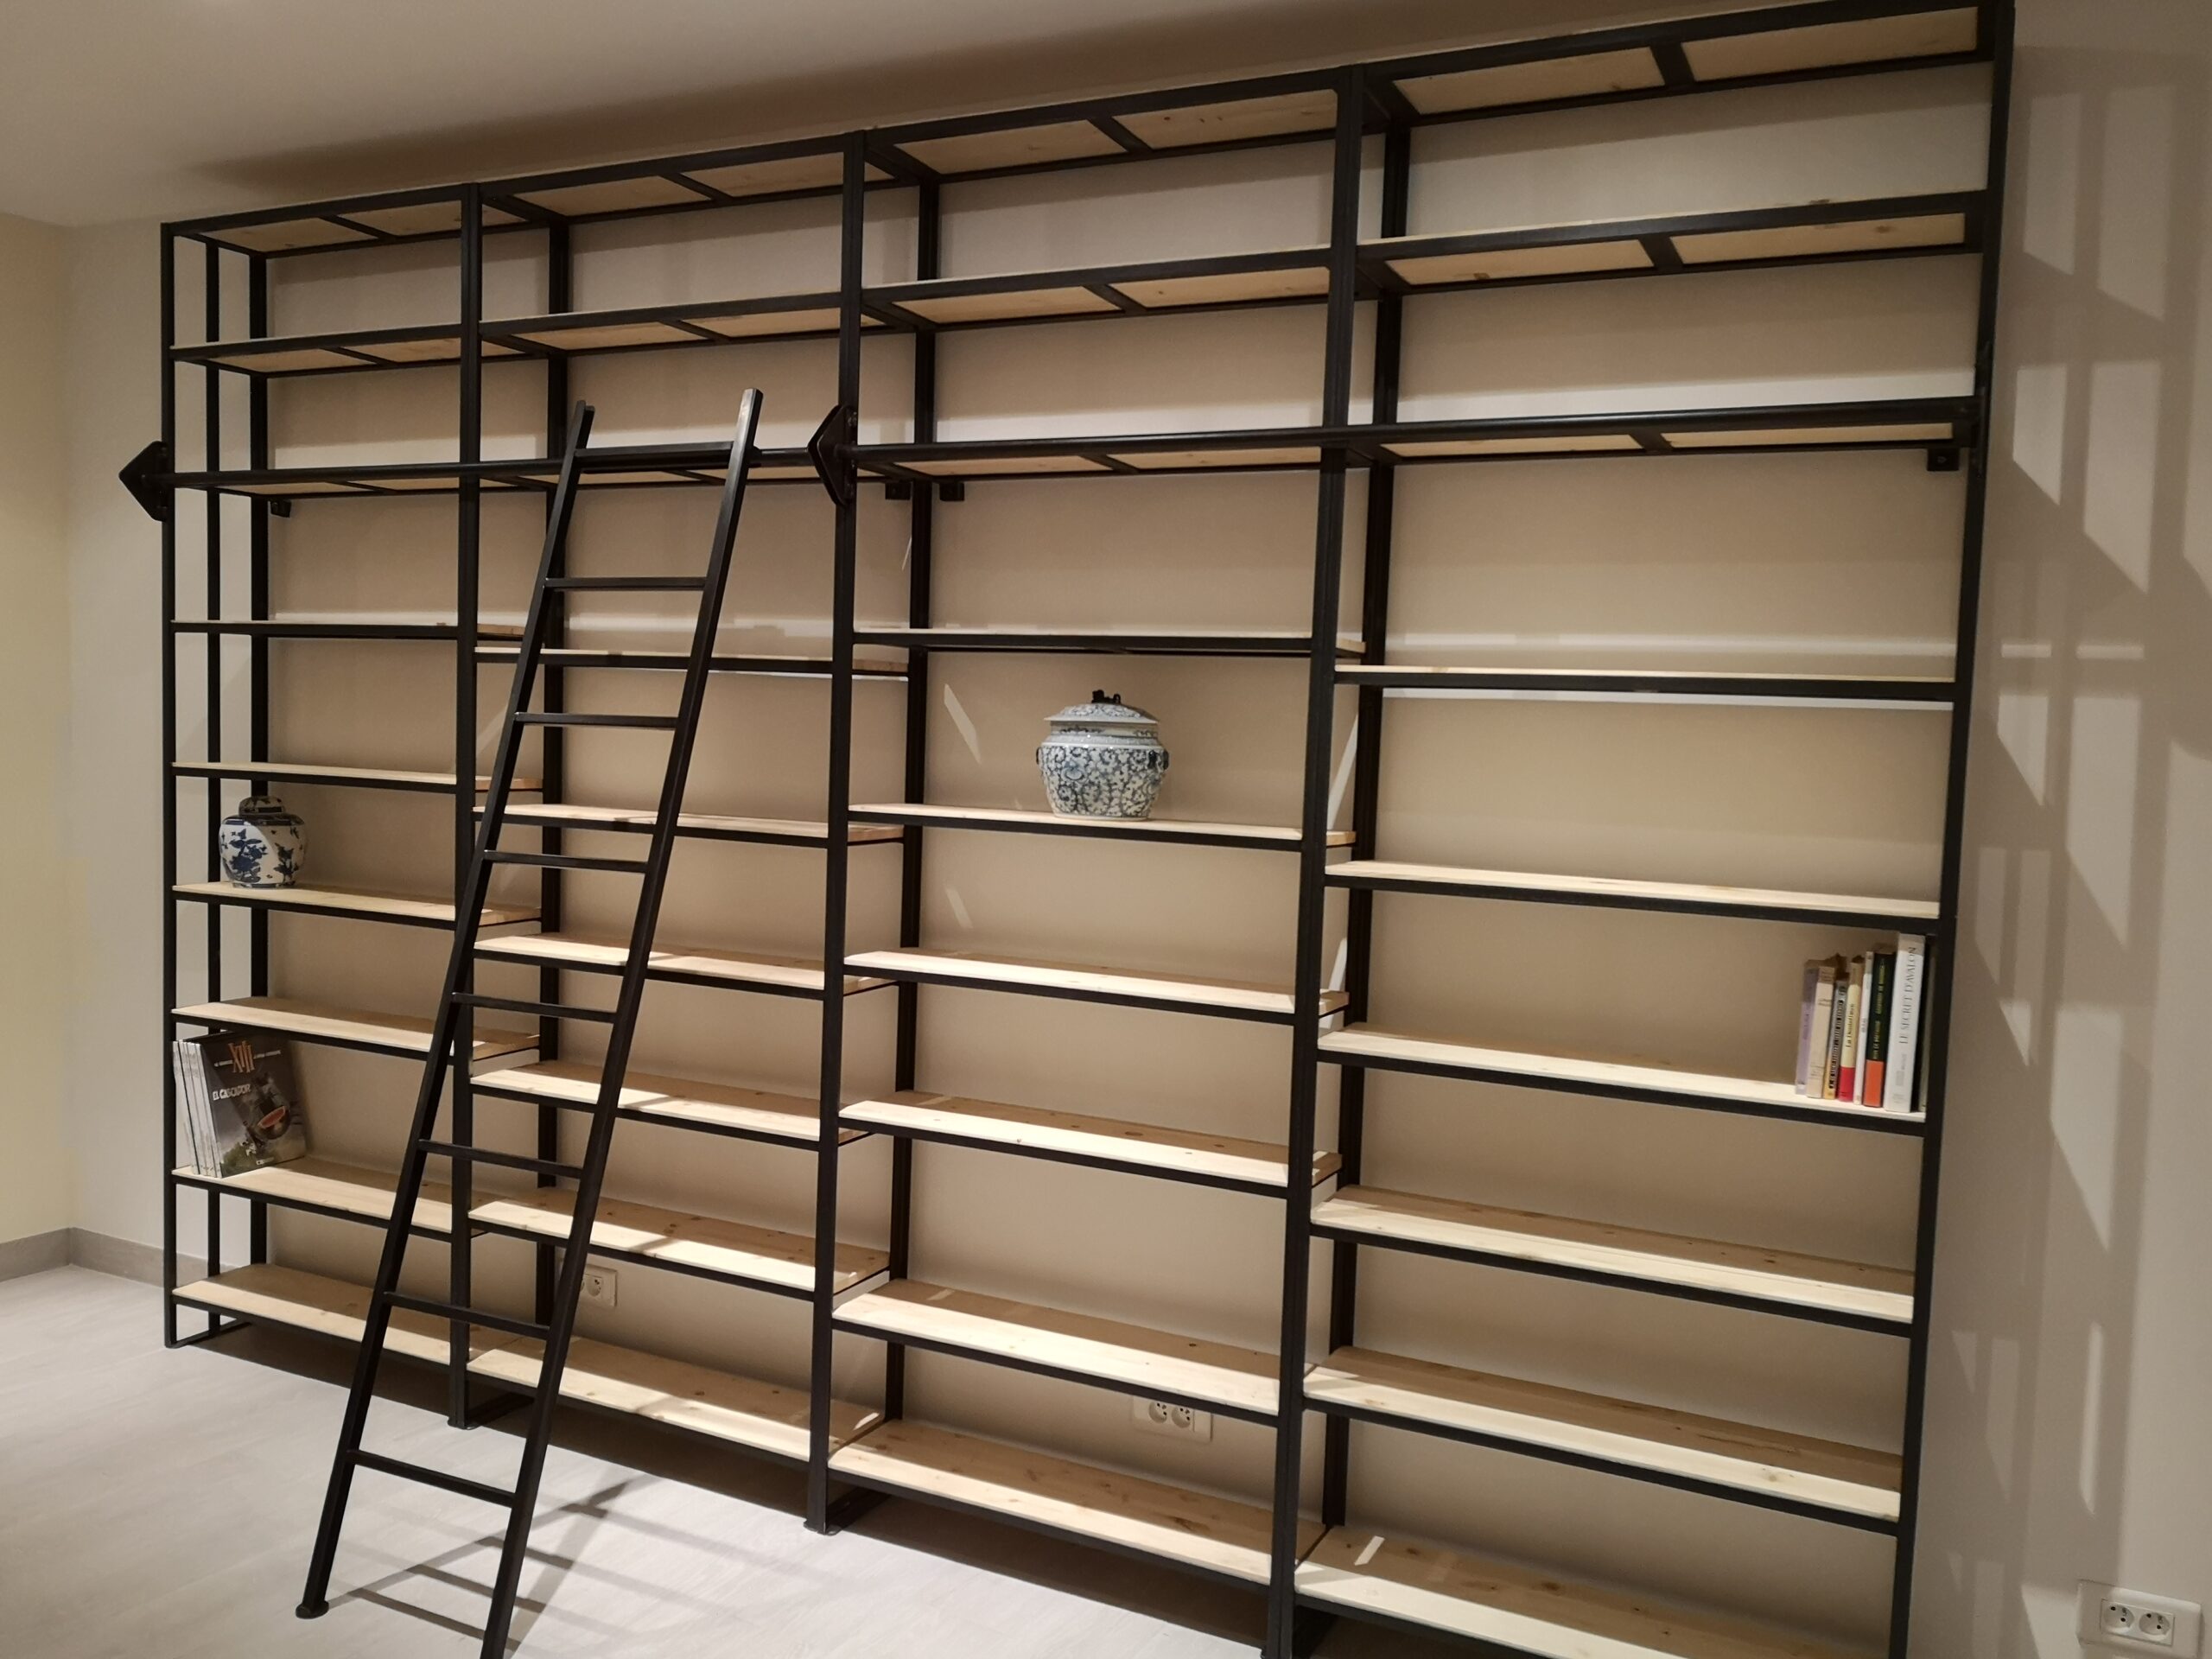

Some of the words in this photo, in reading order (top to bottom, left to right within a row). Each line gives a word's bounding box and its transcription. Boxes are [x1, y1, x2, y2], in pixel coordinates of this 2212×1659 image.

[1904, 946, 1916, 993] D'AVALON
[1901, 994, 1912, 1031] SECRET
[1898, 1033, 1909, 1044] LE
[228, 1040, 255, 1072] XIII
